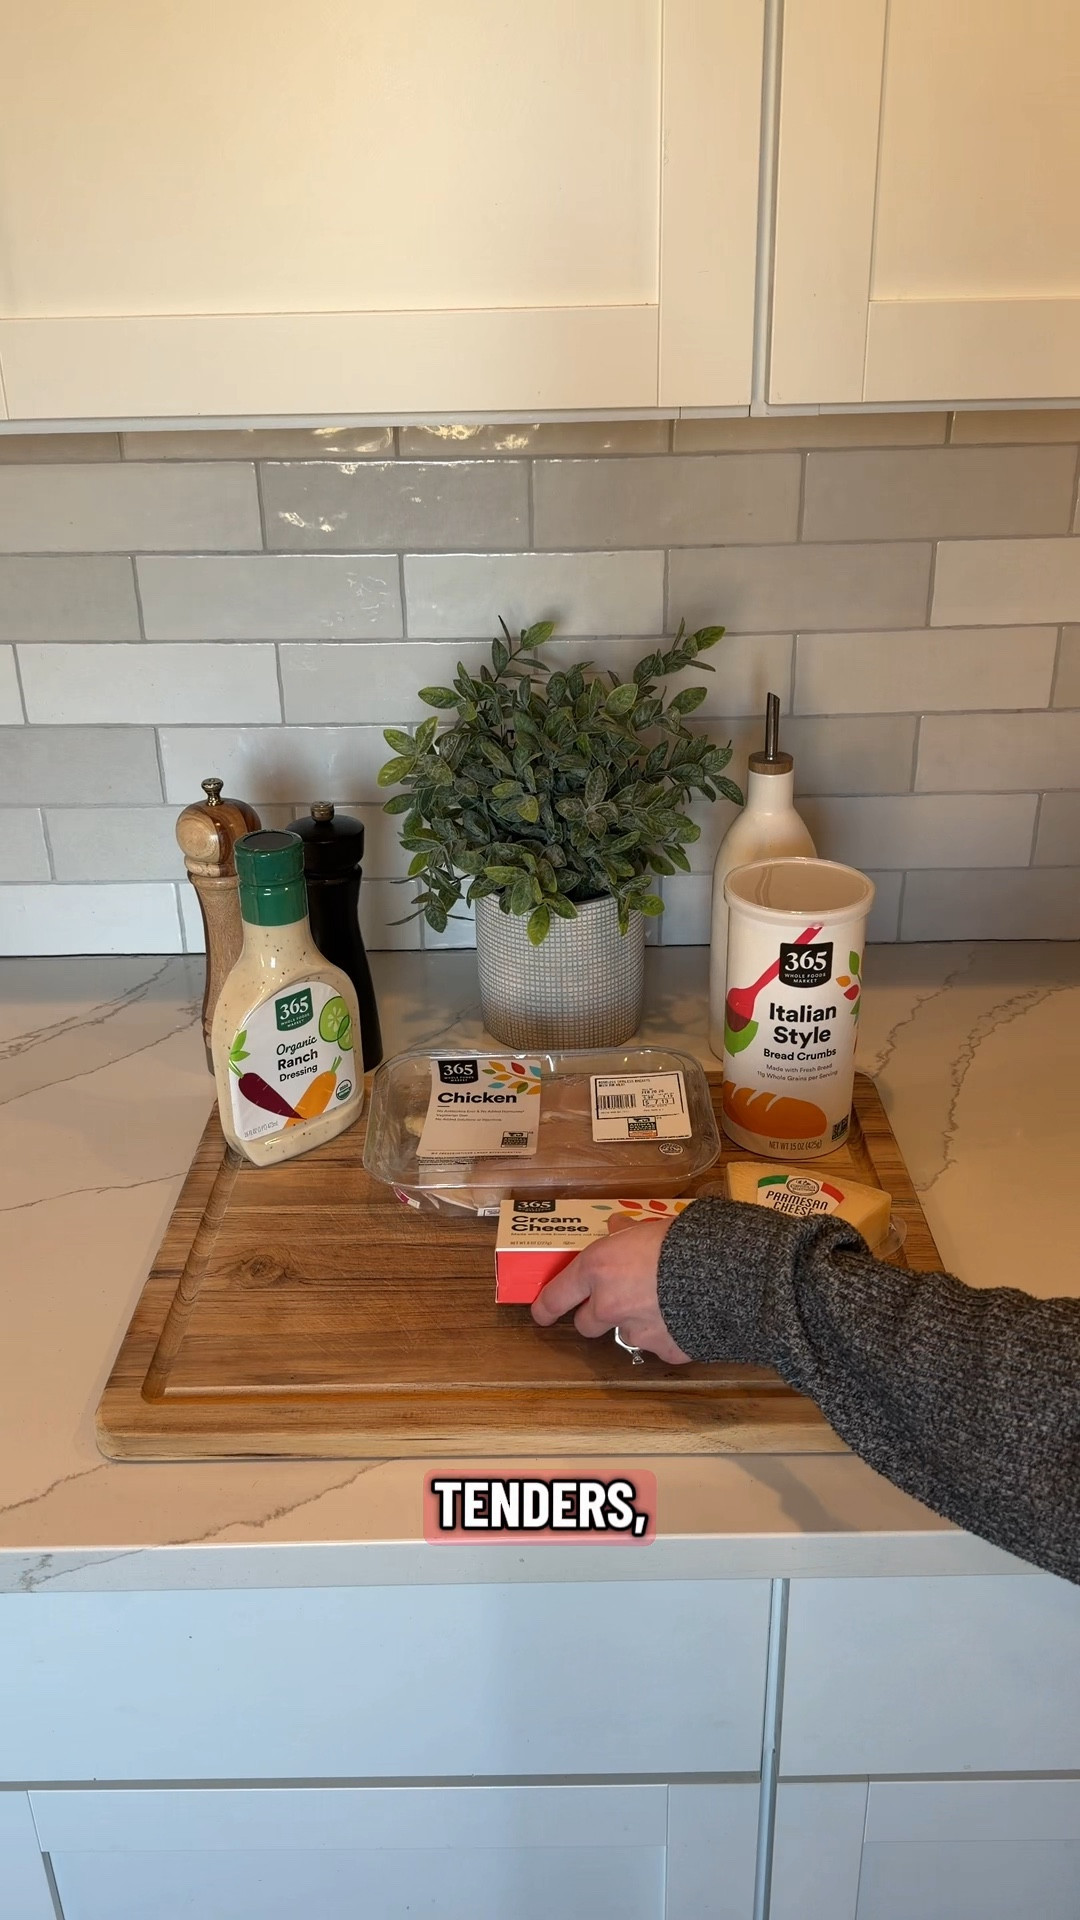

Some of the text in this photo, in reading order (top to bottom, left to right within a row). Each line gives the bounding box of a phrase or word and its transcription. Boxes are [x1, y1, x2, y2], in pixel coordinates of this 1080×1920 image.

[785, 950, 827, 971] 365
[280, 996, 309, 1020] 365
[769, 1002, 837, 1023] Italian
[773, 1026, 831, 1049] Style
[276, 1035, 318, 1056] Organic
[278, 1049, 318, 1071] Ranch
[763, 1048, 837, 1061] Bread Crumbs
[280, 1064, 318, 1082] Dressing
[443, 1063, 474, 1076] 365
[766, 1064, 783, 1072] Made
[817, 1063, 833, 1071] Bread
[766, 1072, 786, 1081] Whole
[819, 1070, 838, 1080] Serving
[437, 1092, 517, 1103] Chicken
[768, 1140, 779, 1150] NET
[780, 1142, 789, 1150] WT
[790, 1142, 797, 1151] 15
[797, 1142, 805, 1150] OZ
[517, 1200, 551, 1209] 365
[766, 1190, 828, 1211] PARMESAN
[773, 1201, 814, 1217] CHEESE
[512, 1215, 582, 1223] Cream
[511, 1223, 589, 1232] Cheese
